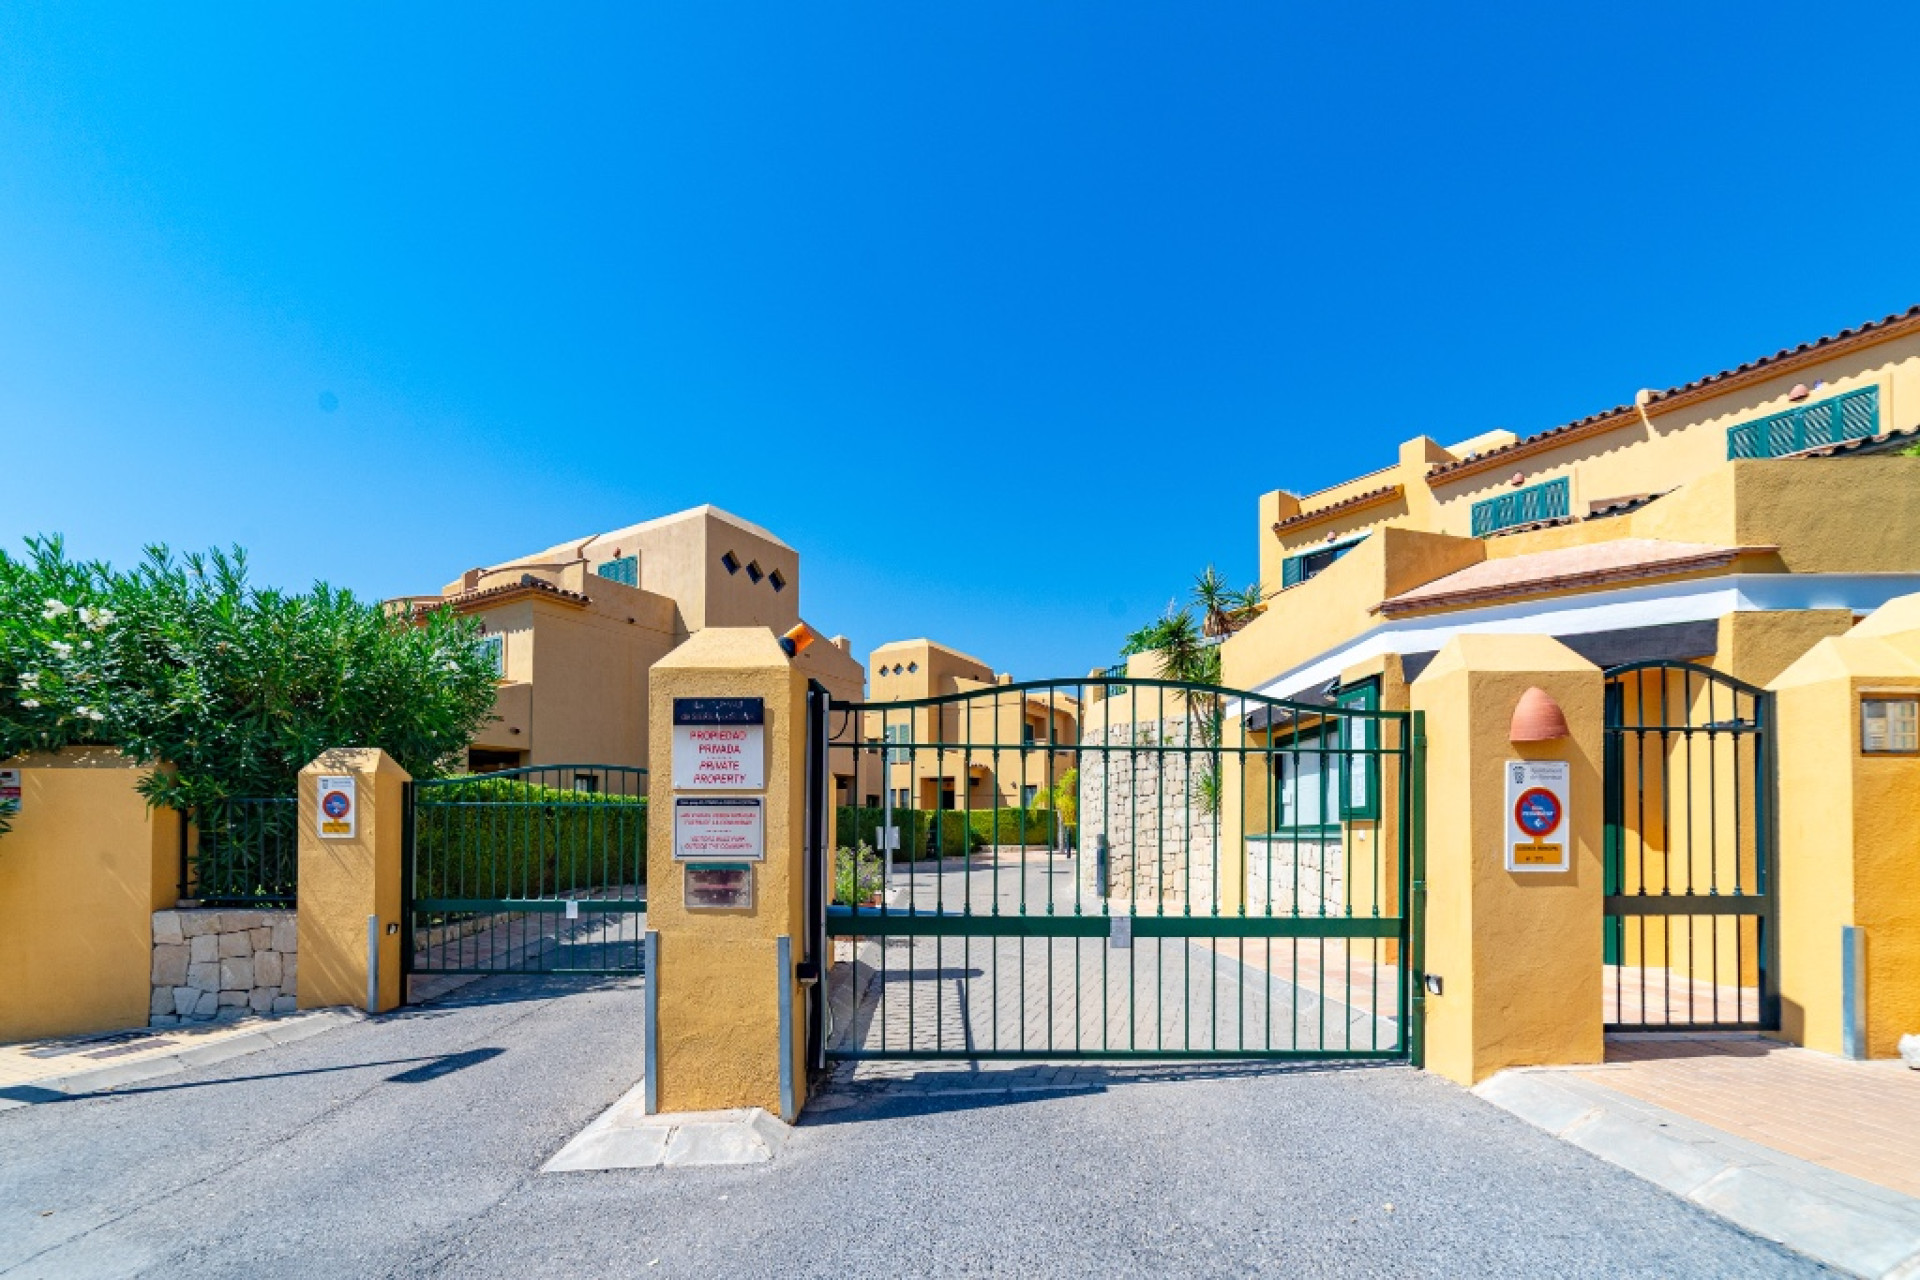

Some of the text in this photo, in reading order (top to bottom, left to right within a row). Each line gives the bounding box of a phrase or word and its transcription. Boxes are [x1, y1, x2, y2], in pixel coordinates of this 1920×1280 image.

[690, 730, 747, 741] PROPIEDAD
[698, 744, 741, 754] PRIVADA
[699, 761, 740, 771] PRIVATE
[693, 773, 747, 784] PROPERTY
